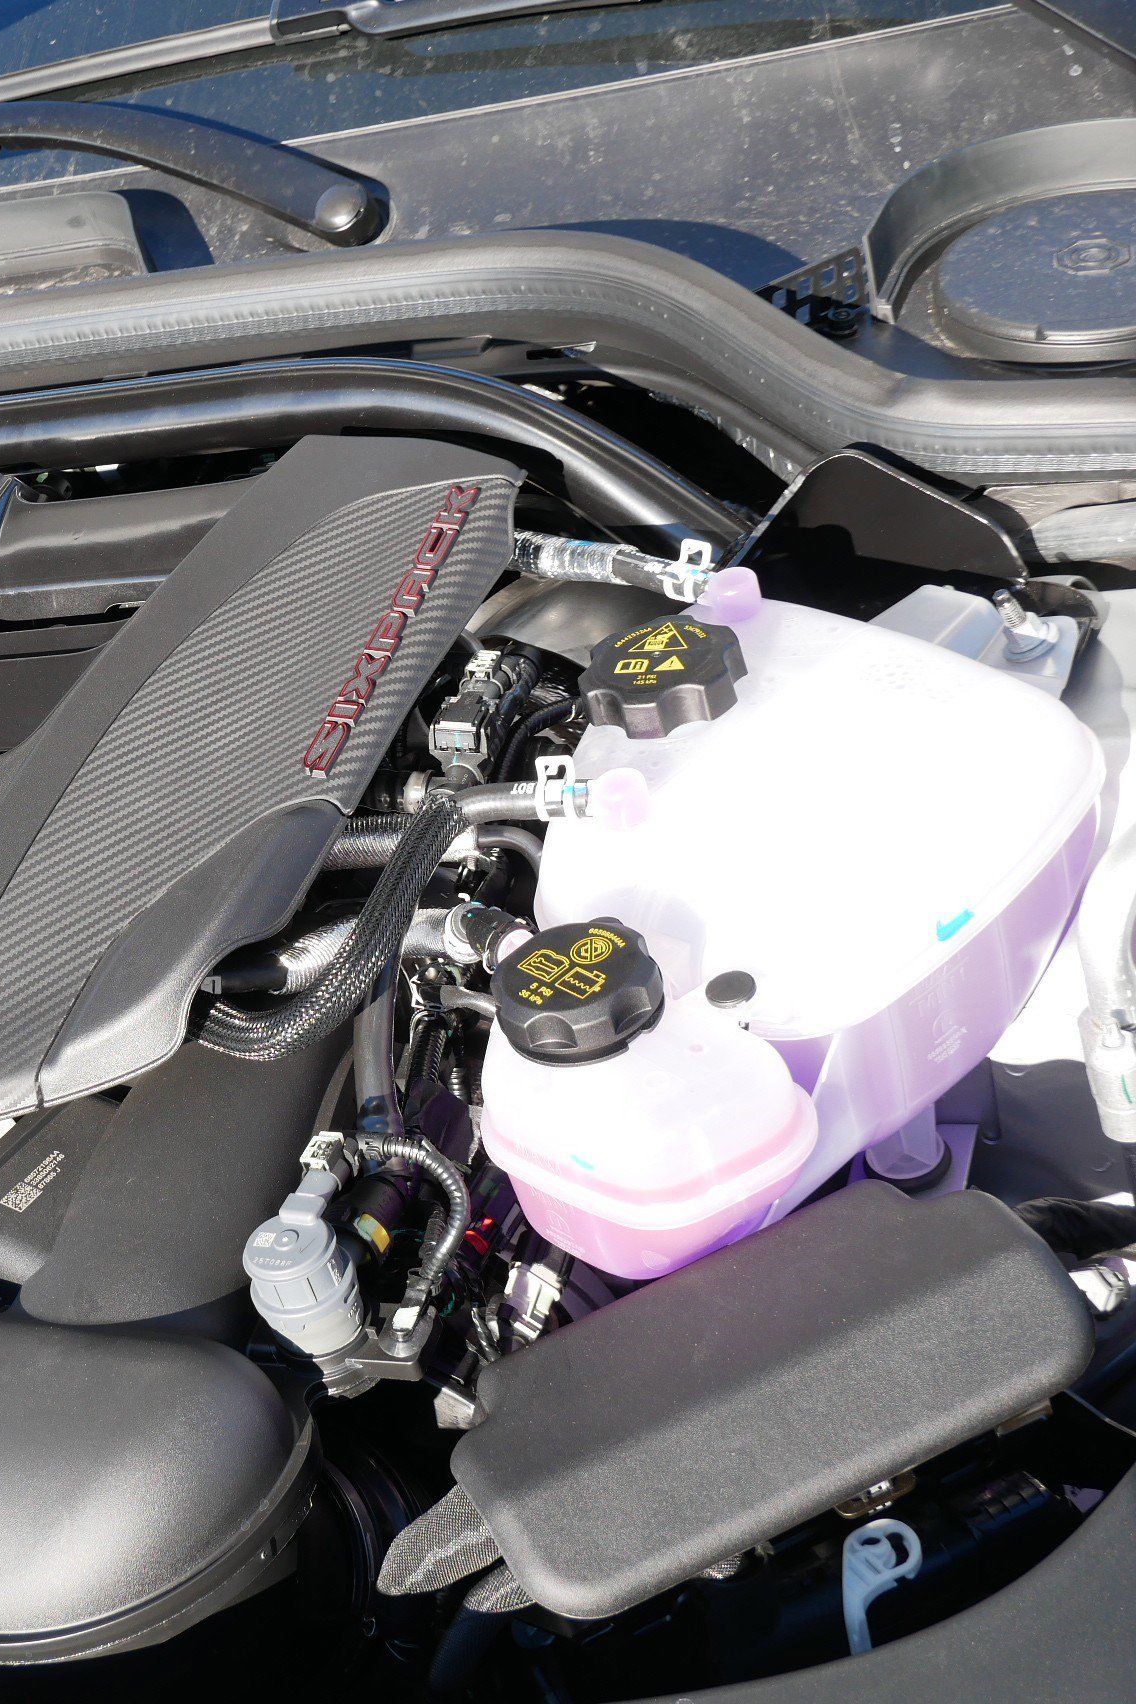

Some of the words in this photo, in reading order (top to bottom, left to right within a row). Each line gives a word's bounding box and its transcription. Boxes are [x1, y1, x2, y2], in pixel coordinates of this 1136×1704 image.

[303, 485, 481, 778] SIXPACK
[510, 783, 536, 795] BOT
[519, 989, 530, 998] 35
[528, 993, 543, 1005] kPa
[538, 985, 554, 997] PSI
